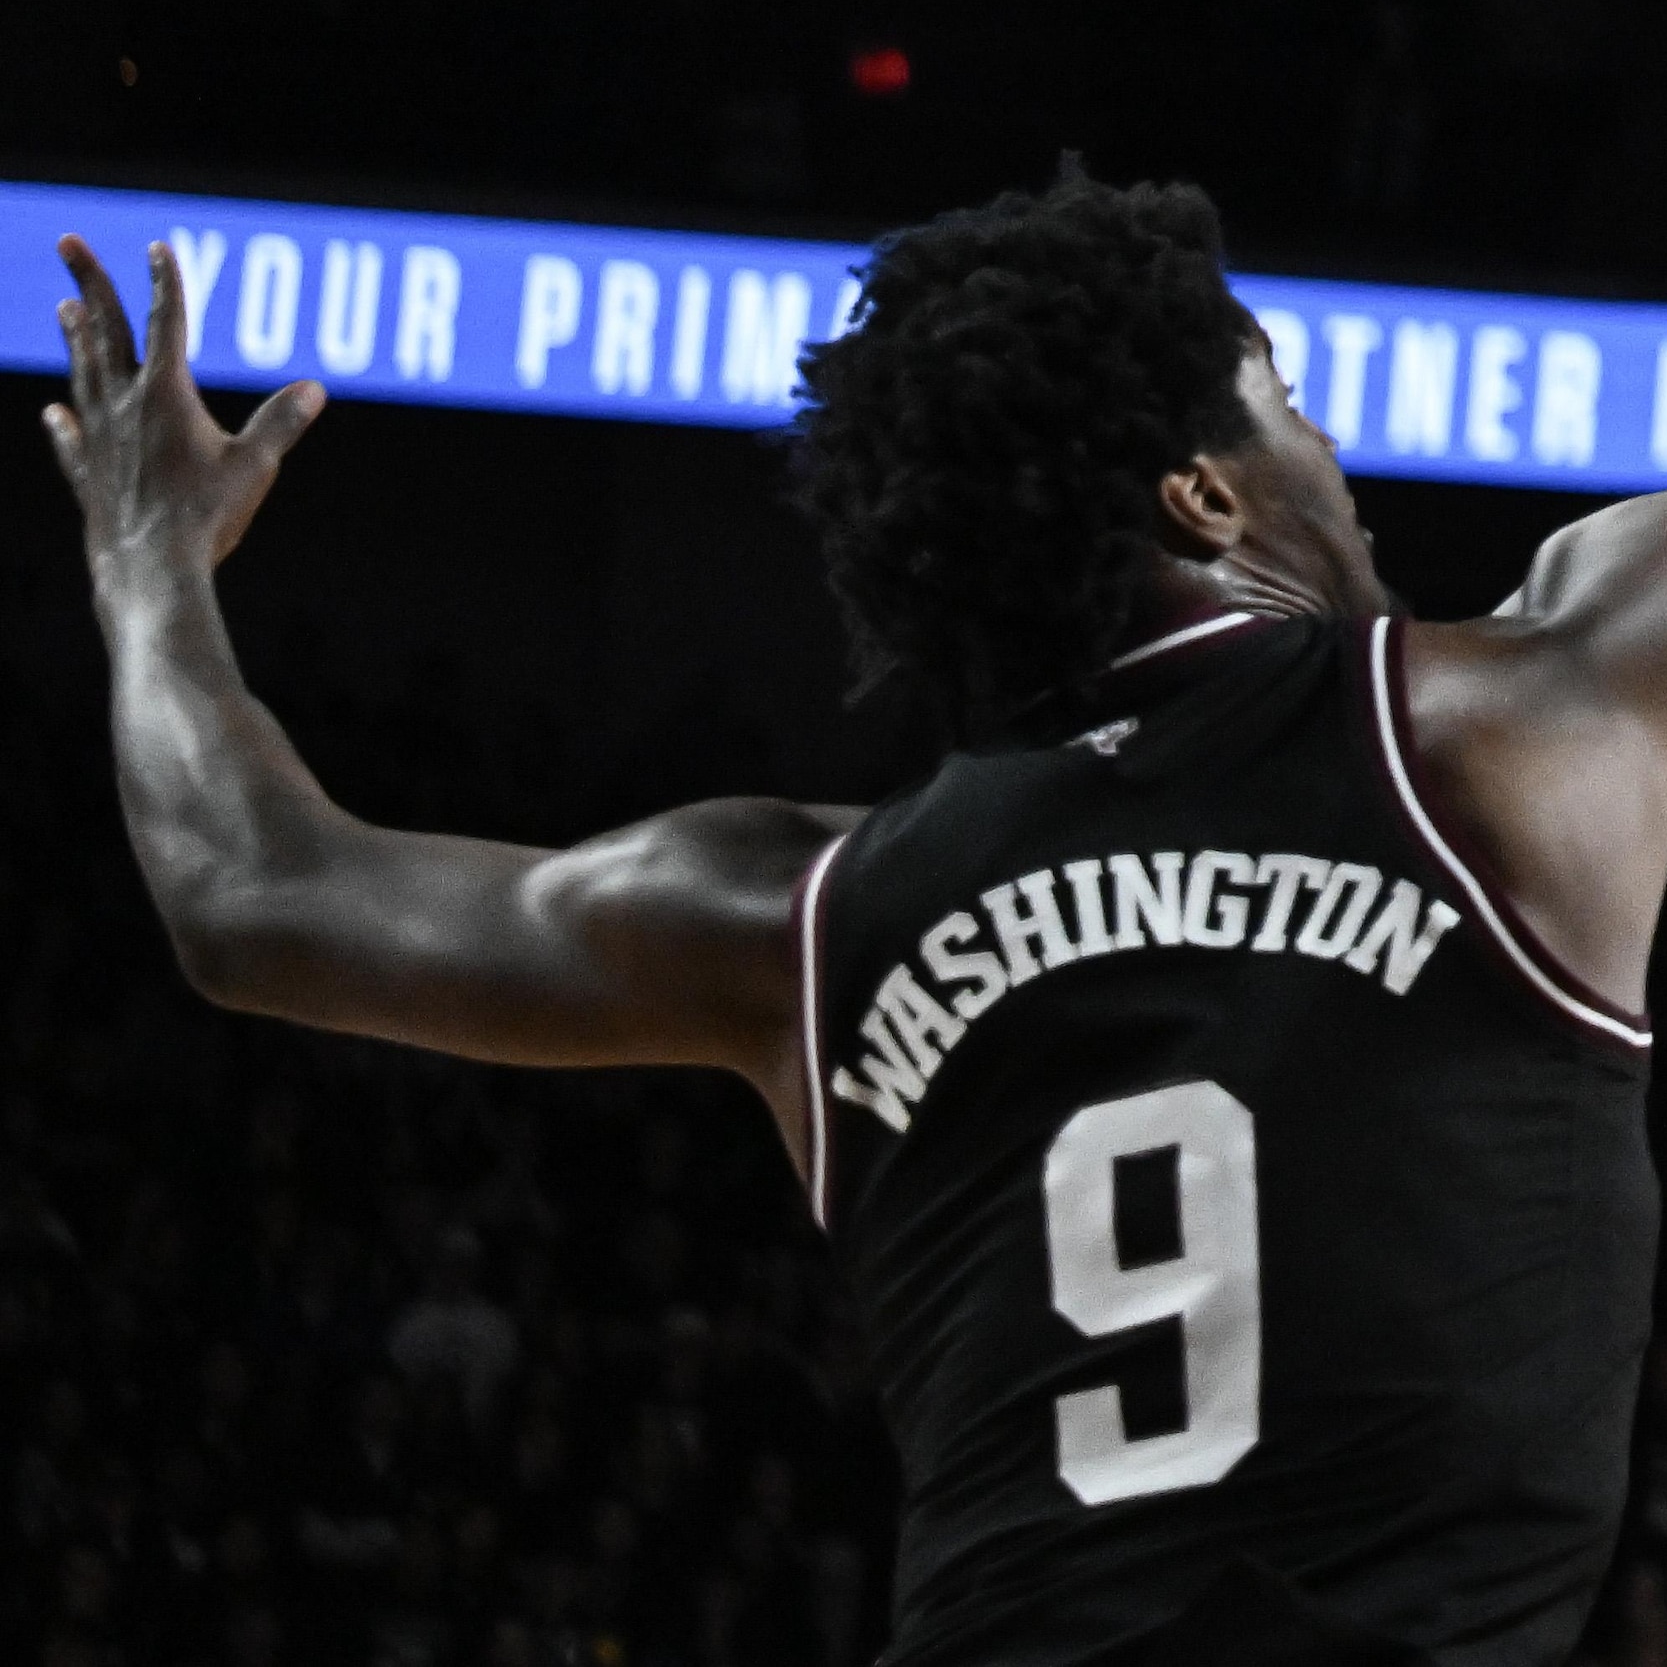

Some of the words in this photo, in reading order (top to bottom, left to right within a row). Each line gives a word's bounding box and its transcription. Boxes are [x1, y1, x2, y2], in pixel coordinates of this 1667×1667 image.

[169, 227, 461, 384] YOUR
[831, 849, 1462, 1135] WASHINGTON
[1043, 1080, 1261, 1507] 9
